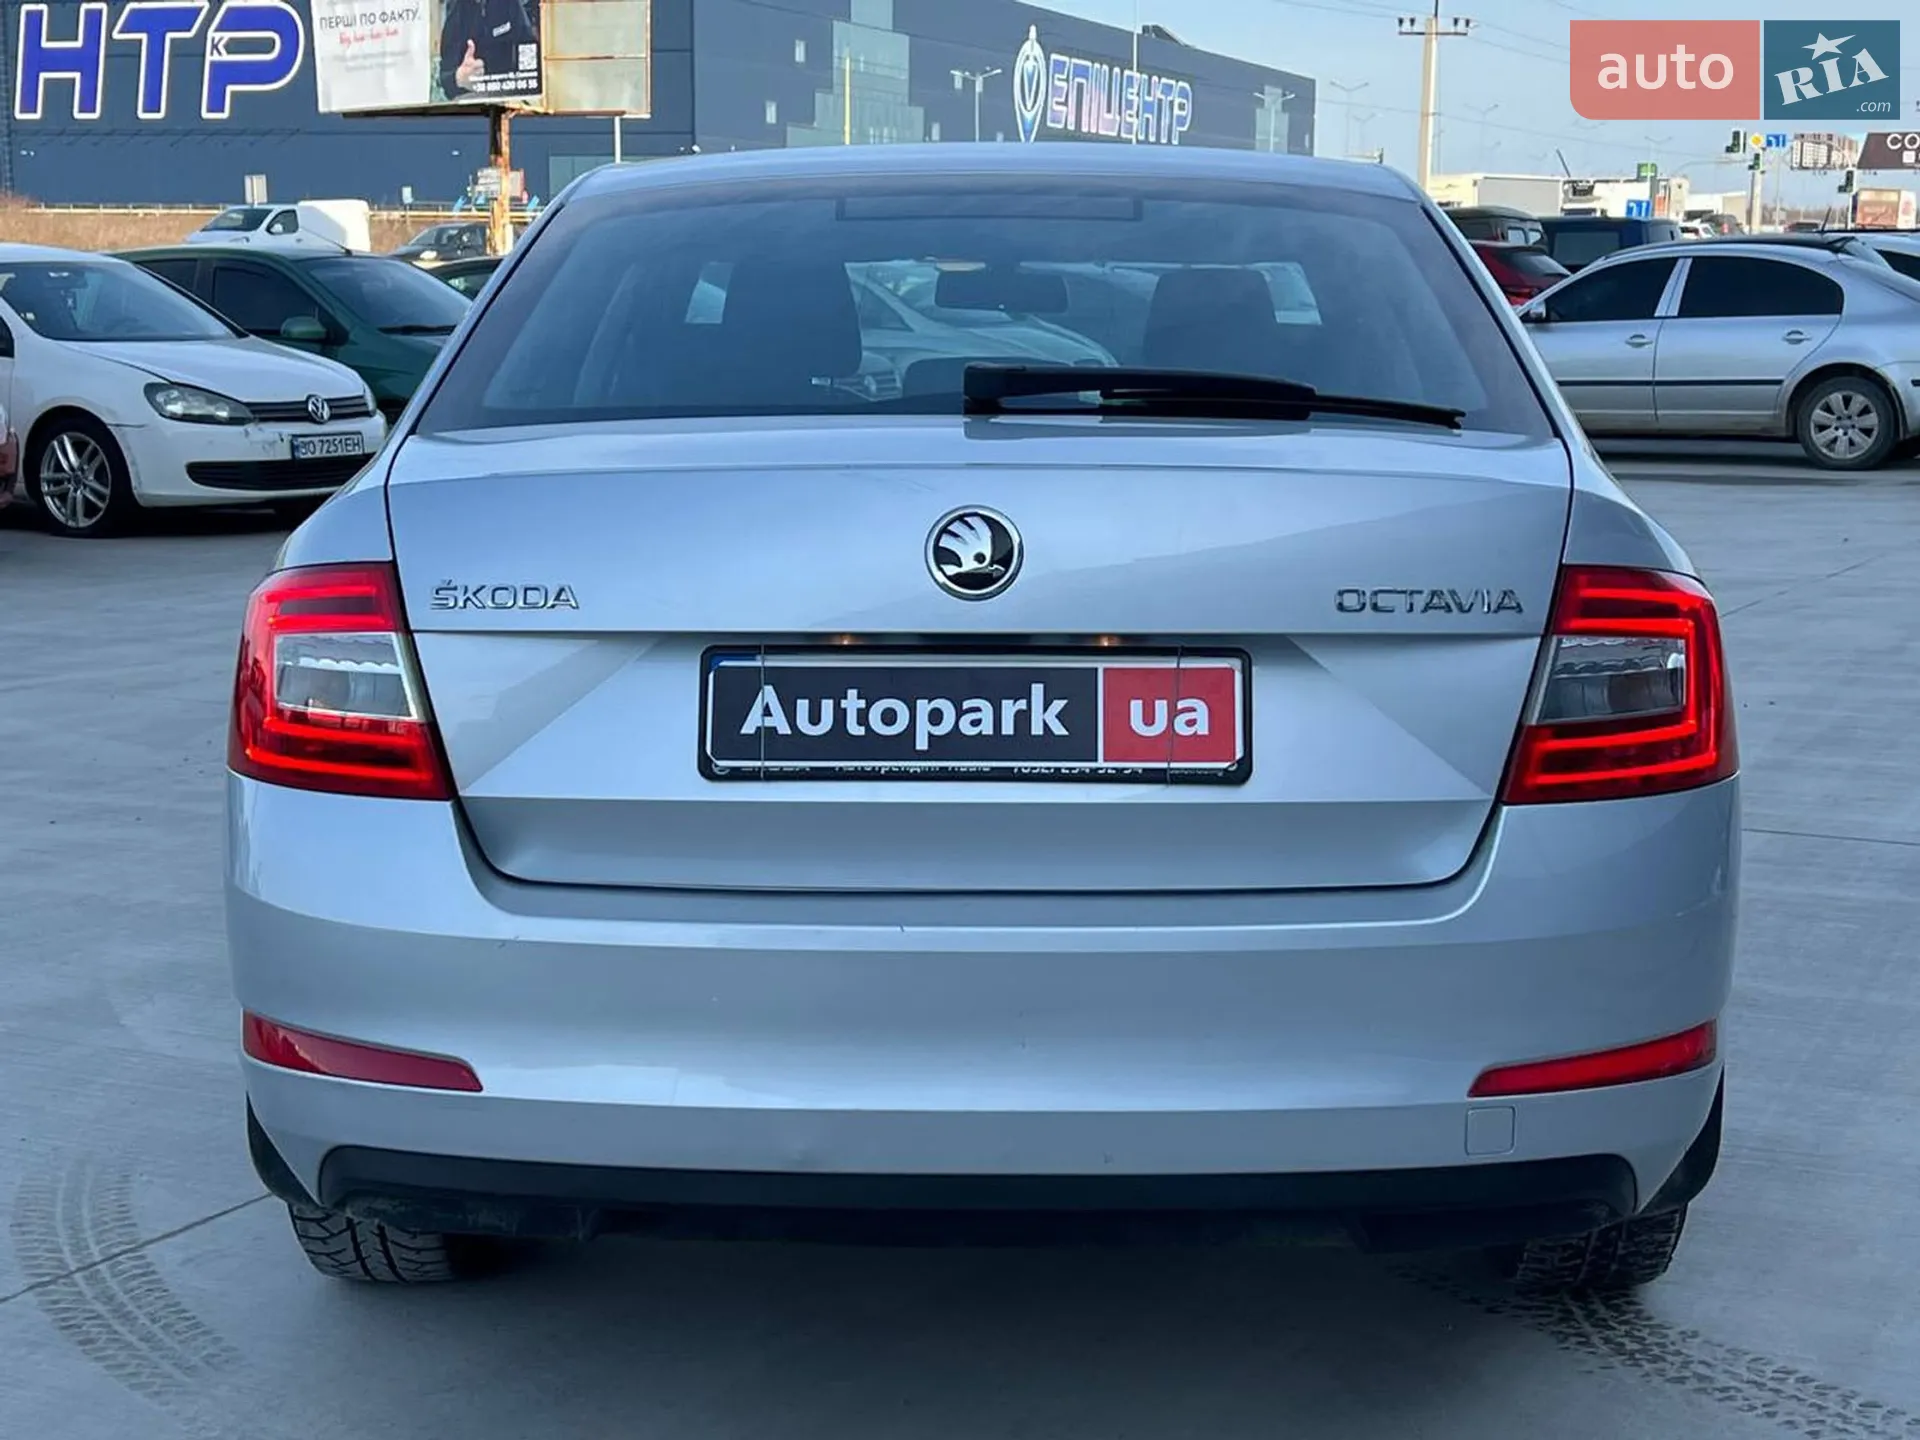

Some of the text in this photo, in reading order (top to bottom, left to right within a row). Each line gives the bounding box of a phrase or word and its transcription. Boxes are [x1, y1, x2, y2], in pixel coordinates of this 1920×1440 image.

[319, 14, 357, 30] ПЕРШІ
[360, 12, 377, 28] ПО
[1047, 53, 1193, 145] ЕПІЦЕНТР
[430, 579, 580, 611] ŠKODA
[1334, 587, 1525, 614] OCTAVIA
[740, 683, 1211, 751] Autopark ua
